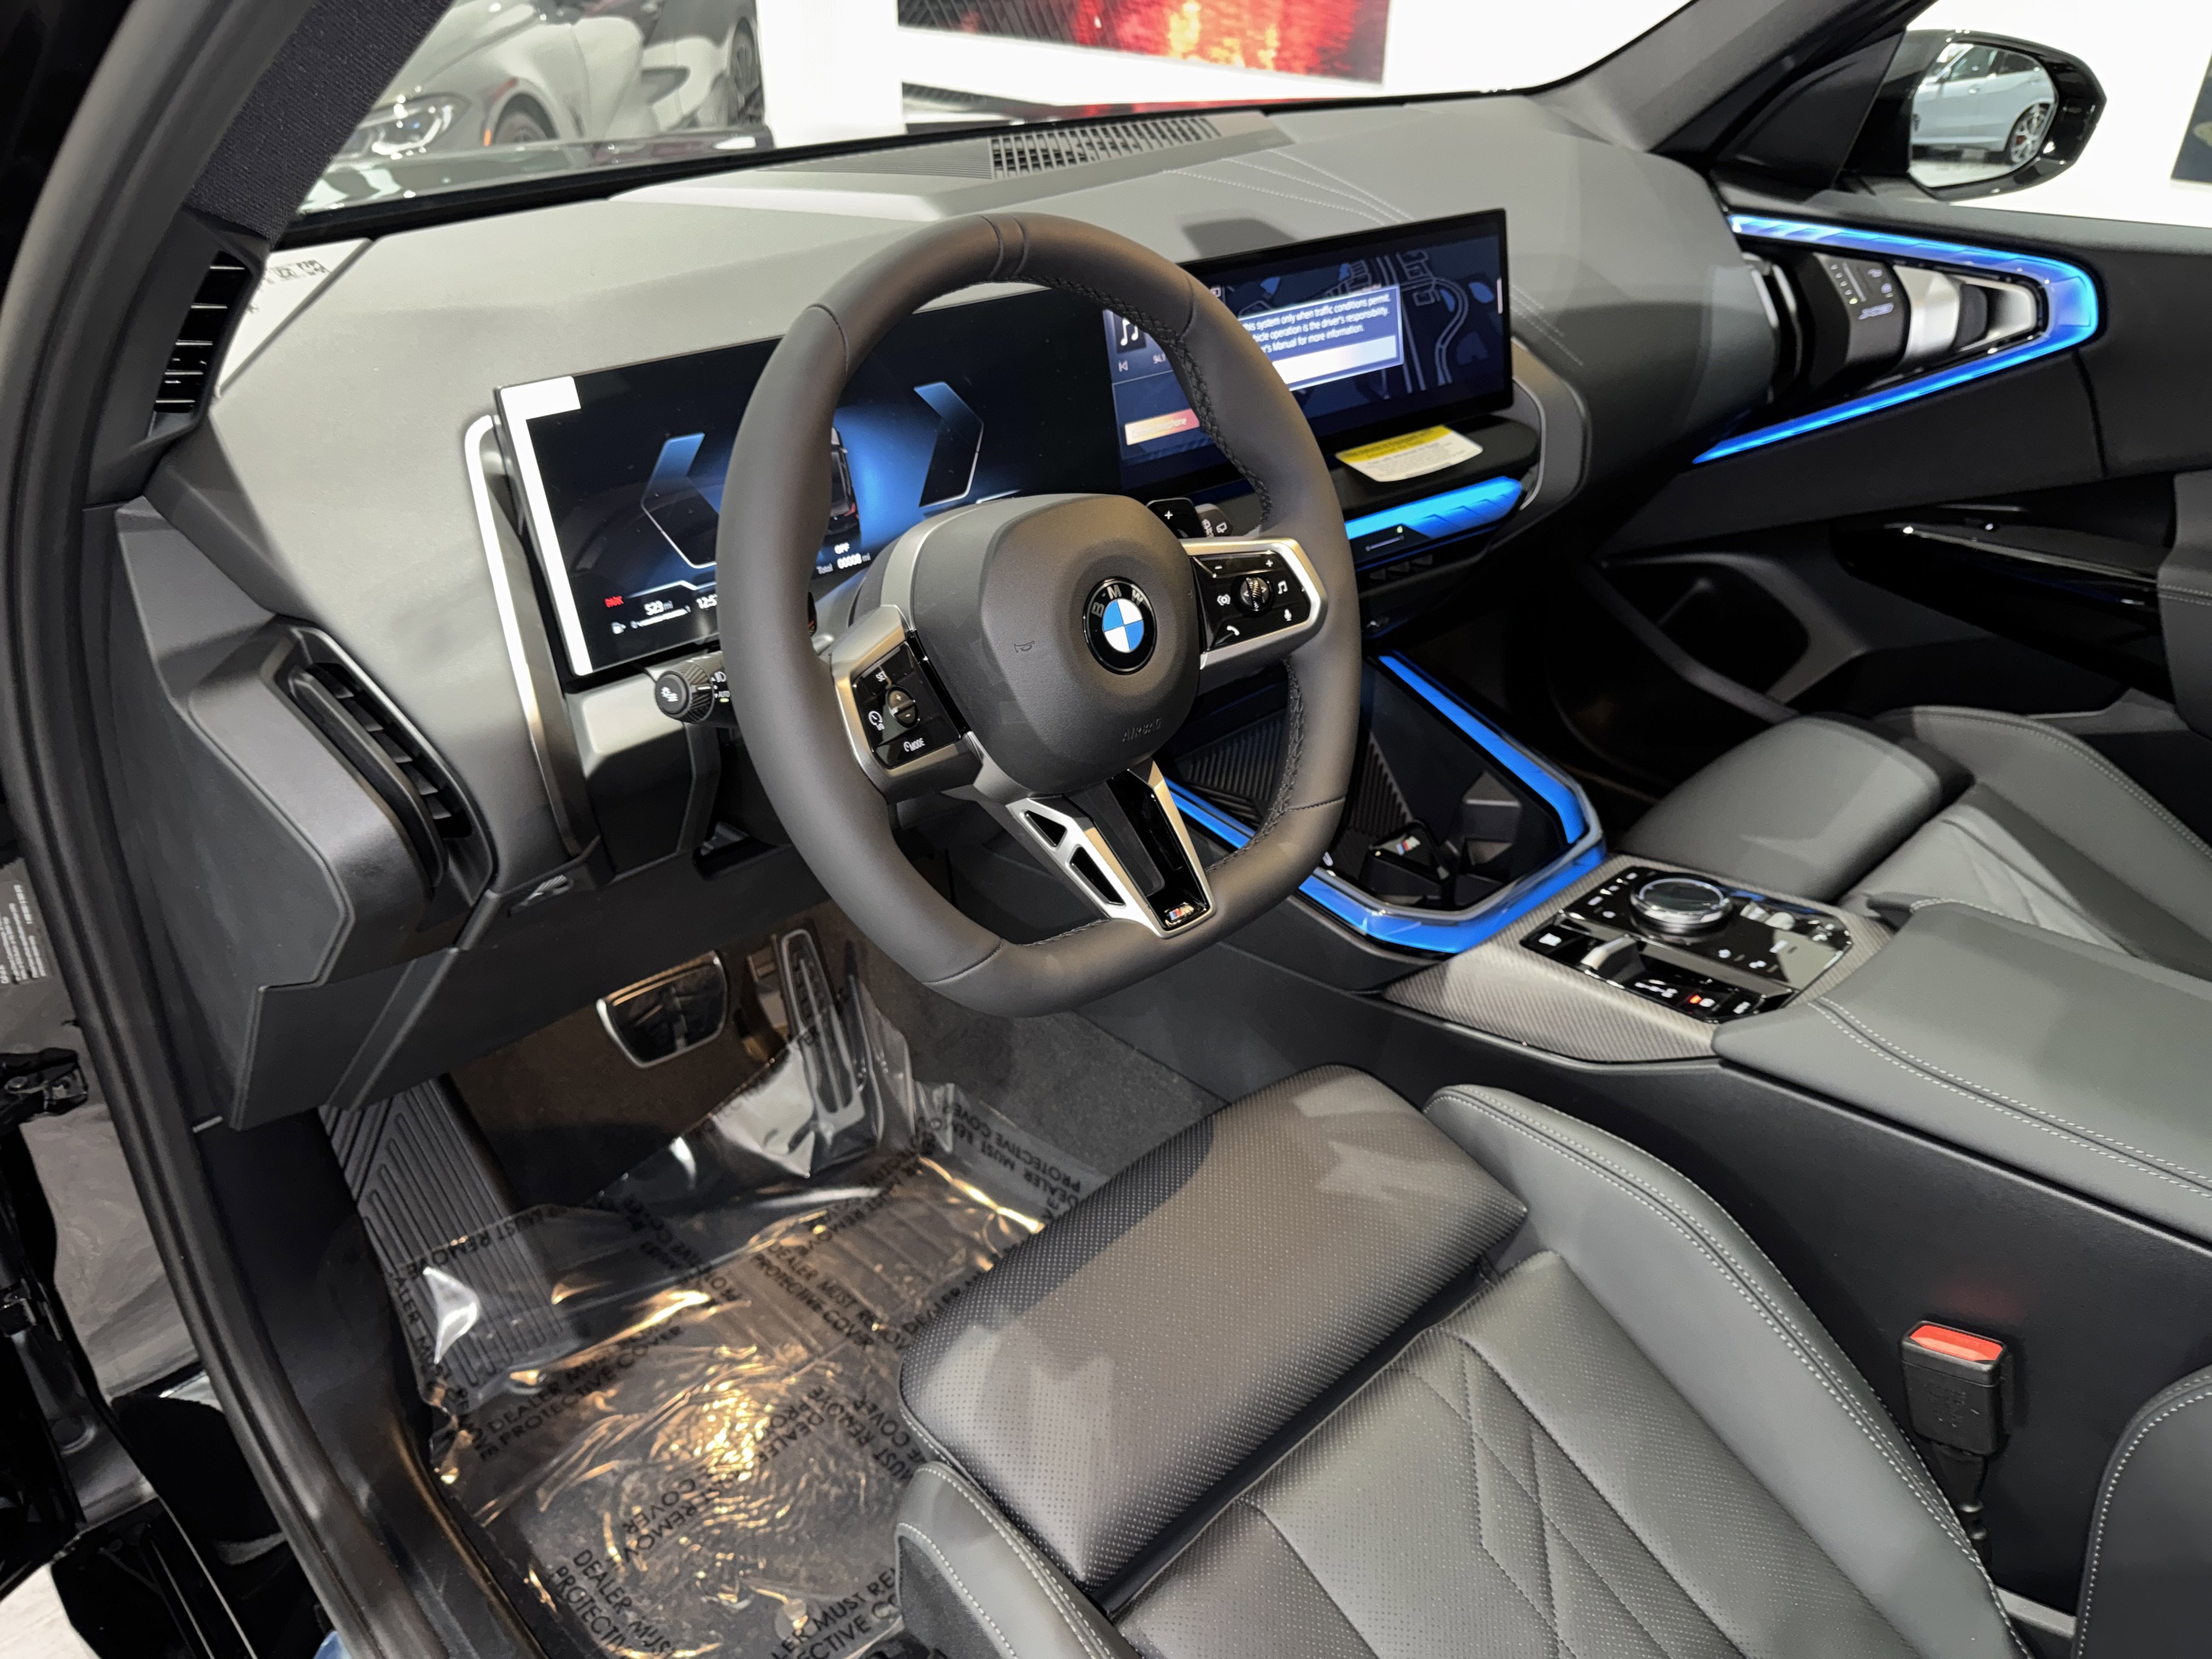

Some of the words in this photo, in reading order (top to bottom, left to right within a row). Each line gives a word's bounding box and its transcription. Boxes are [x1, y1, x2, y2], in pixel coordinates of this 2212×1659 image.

[1256, 317, 1280, 331] system
[1280, 313, 1295, 325] only
[1296, 310, 1314, 321] when
[1314, 305, 1334, 317] traffic
[1334, 299, 1367, 313] conditions
[1270, 325, 1302, 340] operation
[1309, 319, 1321, 330] the
[1321, 315, 1345, 328] driver's
[1272, 336, 1297, 351] Manual
[1297, 335, 1307, 346] for
[1308, 332, 1325, 343] more
[816, 563, 833, 575] Total
[1091, 584, 1145, 618] BMW
[909, 737, 926, 752] MODE
[995, 1132, 1081, 1193] PROTECTIVE
[487, 1380, 562, 1434] DEALER
[853, 1395, 911, 1448] COVER
[622, 1478, 696, 1535] COVER
[573, 1549, 633, 1615] DEALER
[811, 1592, 866, 1632] MUST
